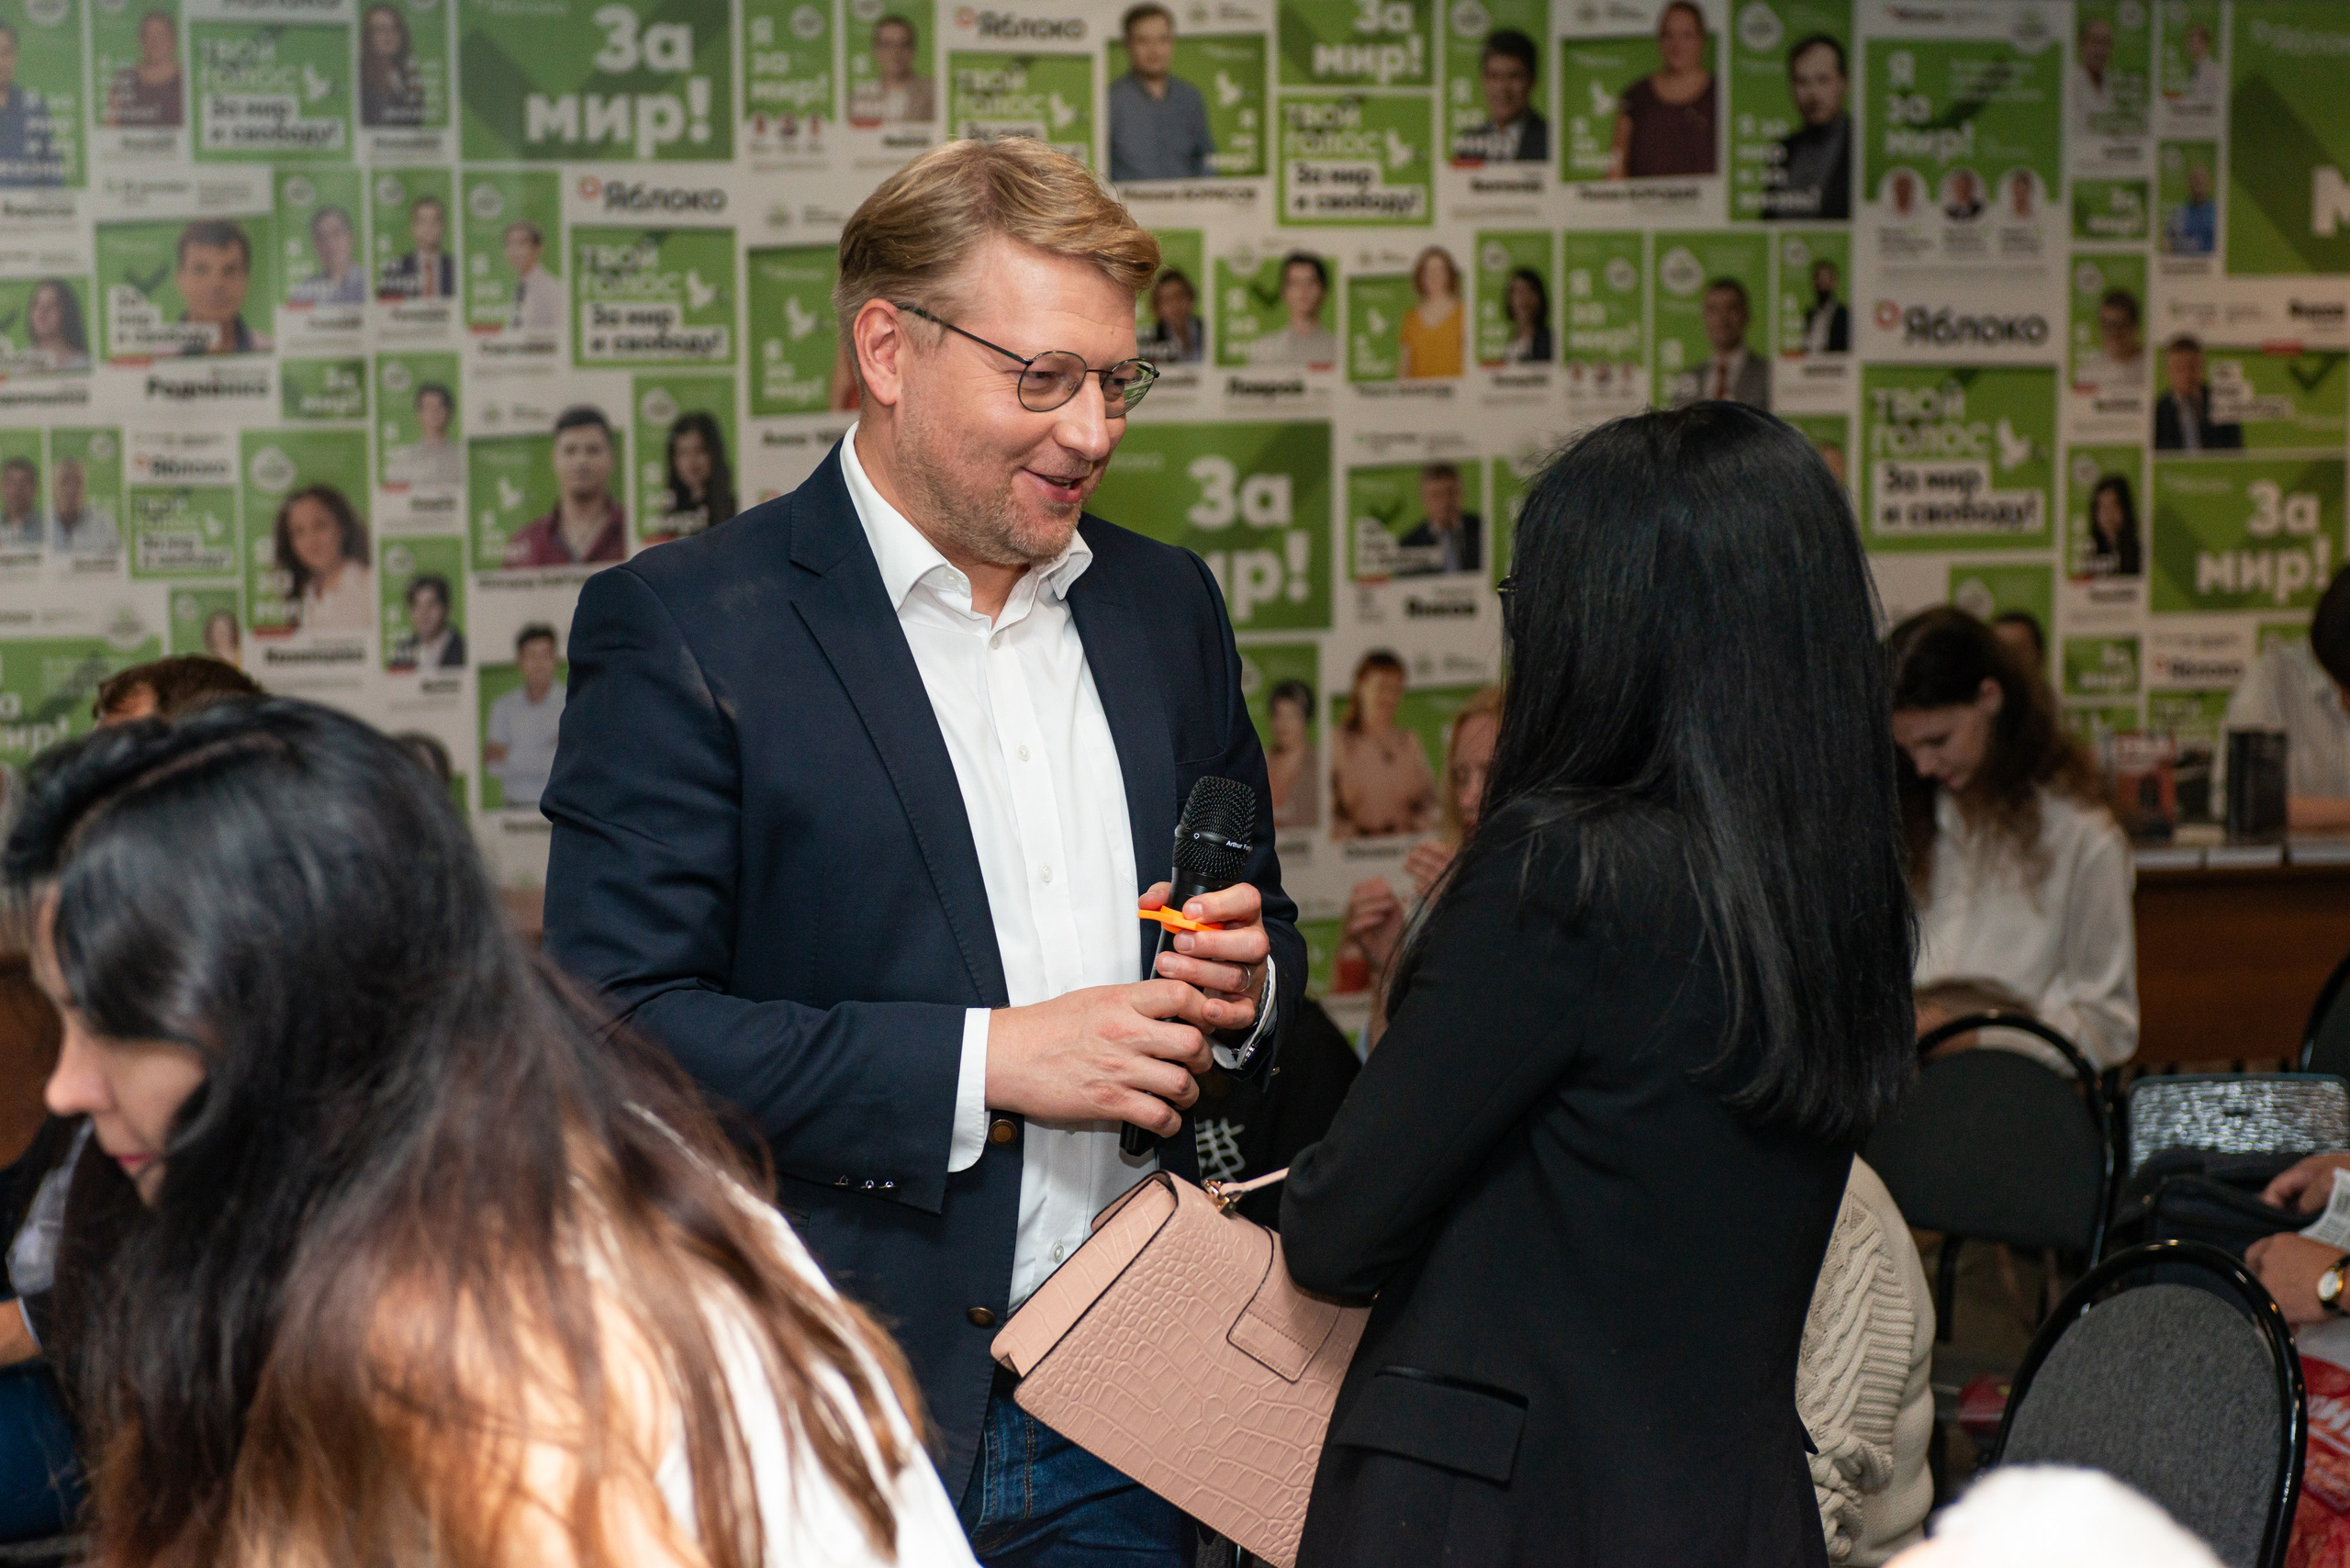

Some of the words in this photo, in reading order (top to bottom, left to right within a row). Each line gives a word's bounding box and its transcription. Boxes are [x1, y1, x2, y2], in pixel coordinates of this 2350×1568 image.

[979, 11, 1087, 41] Яблоко
[1354, 0, 1414, 32] За
[593, 4, 693, 73] За
[1314, 35, 1424, 84] мир!
[1888, 50, 1915, 87] Я
[526, 77, 712, 160] мир!
[1886, 95, 1931, 124] за
[1885, 121, 1975, 166] мир!
[602, 180, 730, 216] Яблоко
[1902, 304, 2051, 348] Яблоко
[1871, 422, 1992, 455] ГОЛОС
[1186, 455, 1292, 531] За
[1885, 459, 1918, 494] За
[1925, 467, 1983, 508] мир
[1908, 493, 2038, 532] свободу!
[2248, 480, 2320, 537] За
[1206, 529, 1311, 624] р!
[2197, 534, 2331, 606] мир!
[1225, 840, 1243, 849] Arthur
